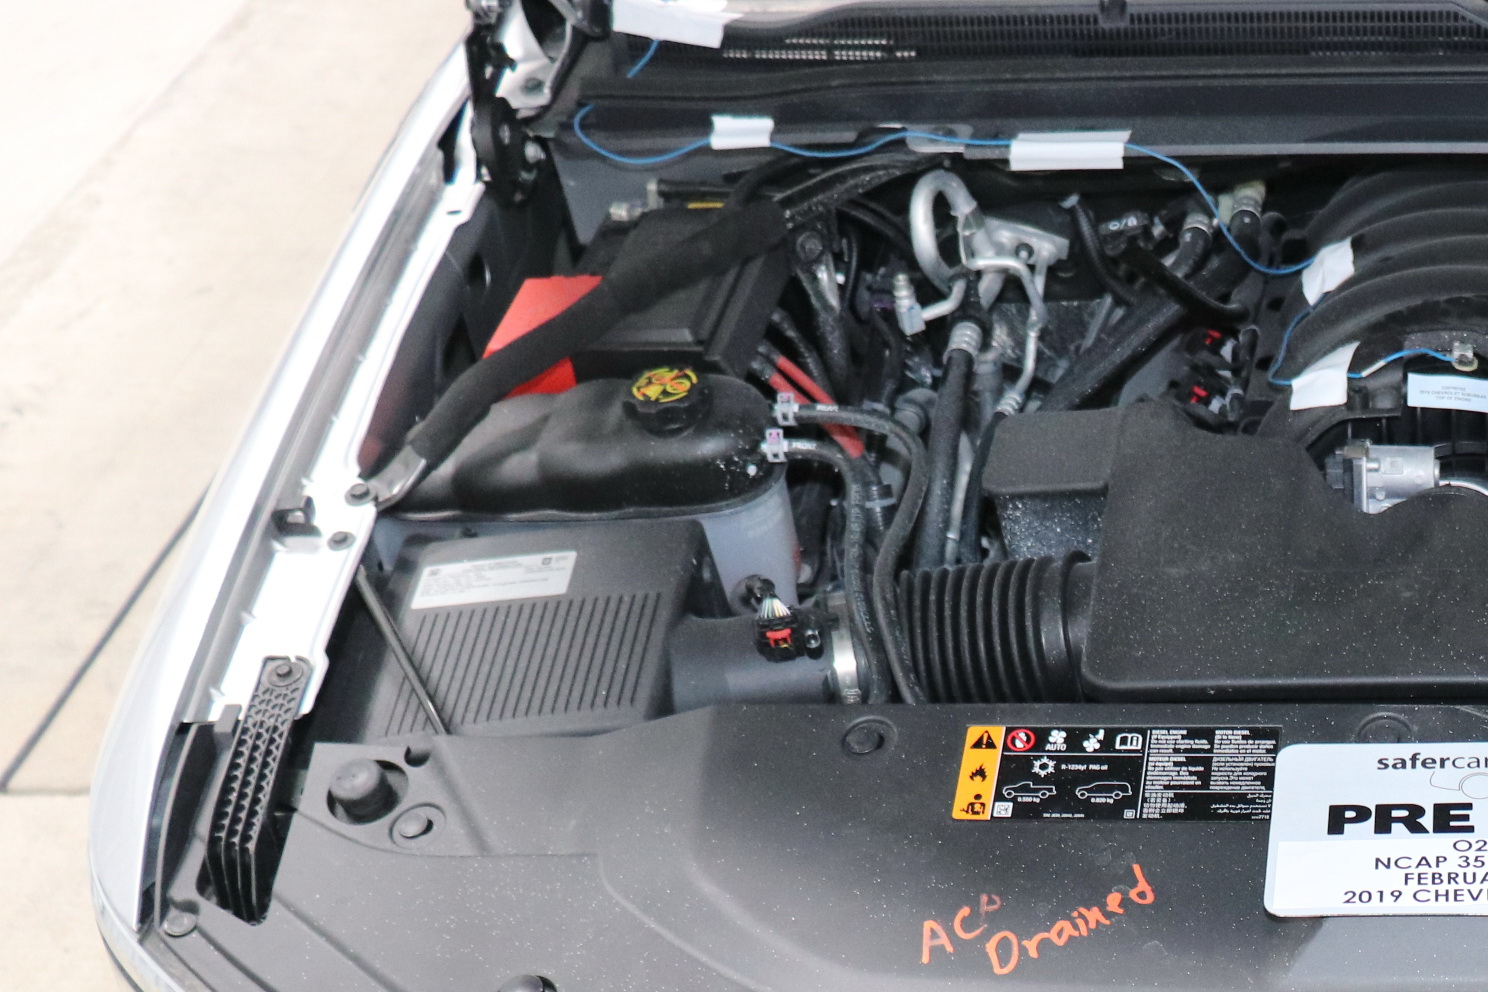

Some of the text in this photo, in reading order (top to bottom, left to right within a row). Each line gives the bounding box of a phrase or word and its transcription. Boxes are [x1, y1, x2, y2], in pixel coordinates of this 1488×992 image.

[792, 442, 816, 450] FRONT
[1327, 802, 1474, 836] PRE
[1374, 856, 1448, 870] NCAP
[1457, 855, 1486, 869] 35
[1342, 890, 1402, 904] 2019
[985, 863, 1155, 975] Drained
